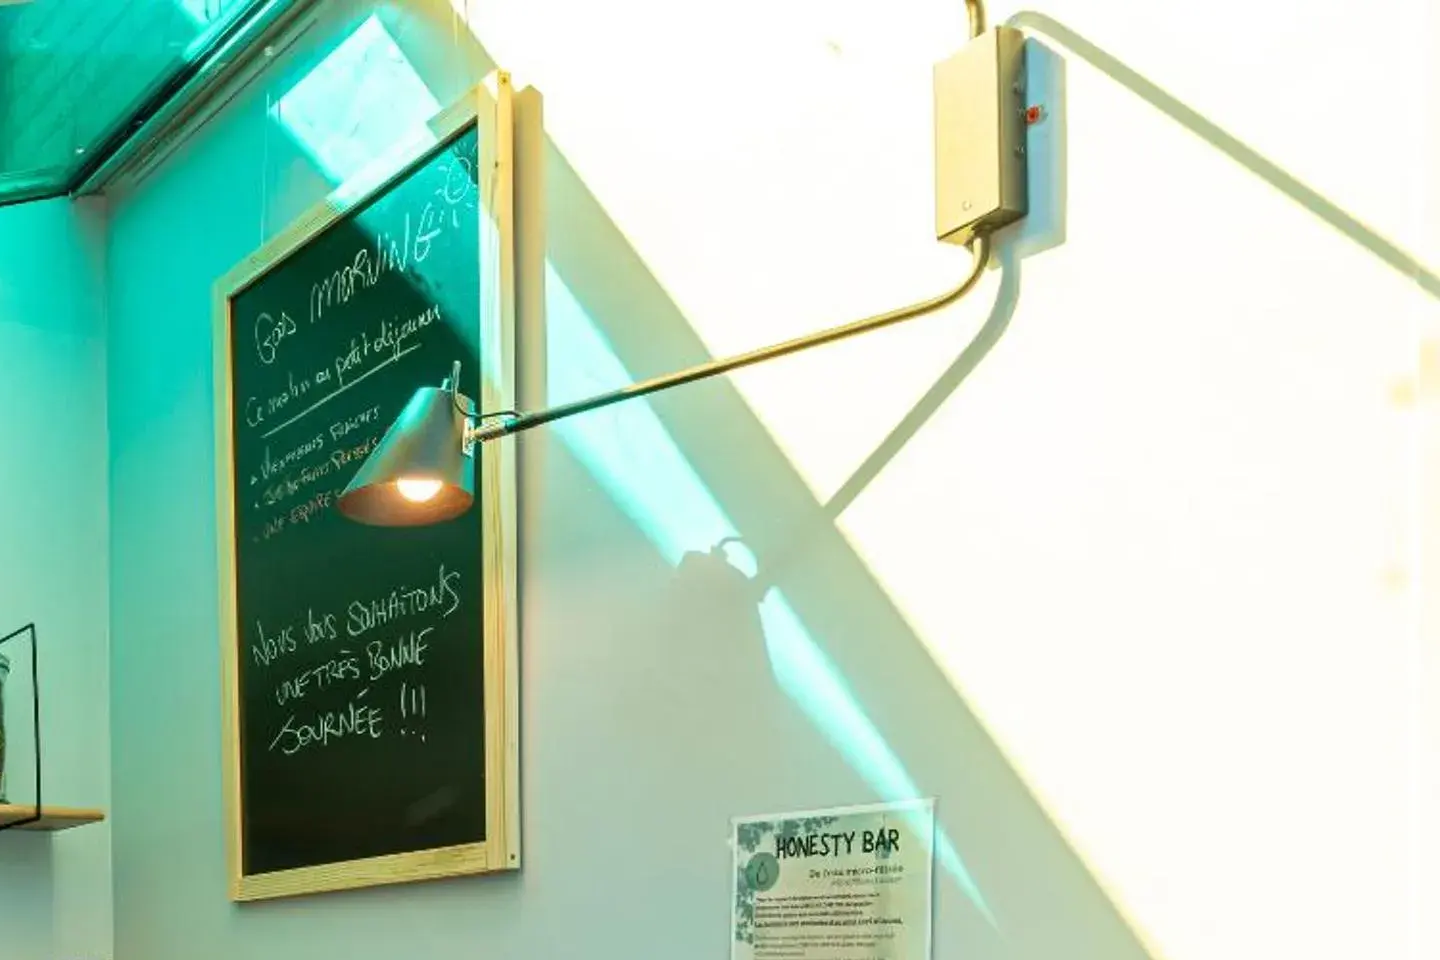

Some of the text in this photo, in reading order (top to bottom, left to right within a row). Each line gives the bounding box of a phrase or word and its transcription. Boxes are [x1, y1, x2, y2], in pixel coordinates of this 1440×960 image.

[366, 626, 435, 681] BONNE
[775, 828, 900, 860] HONESTY BAR
